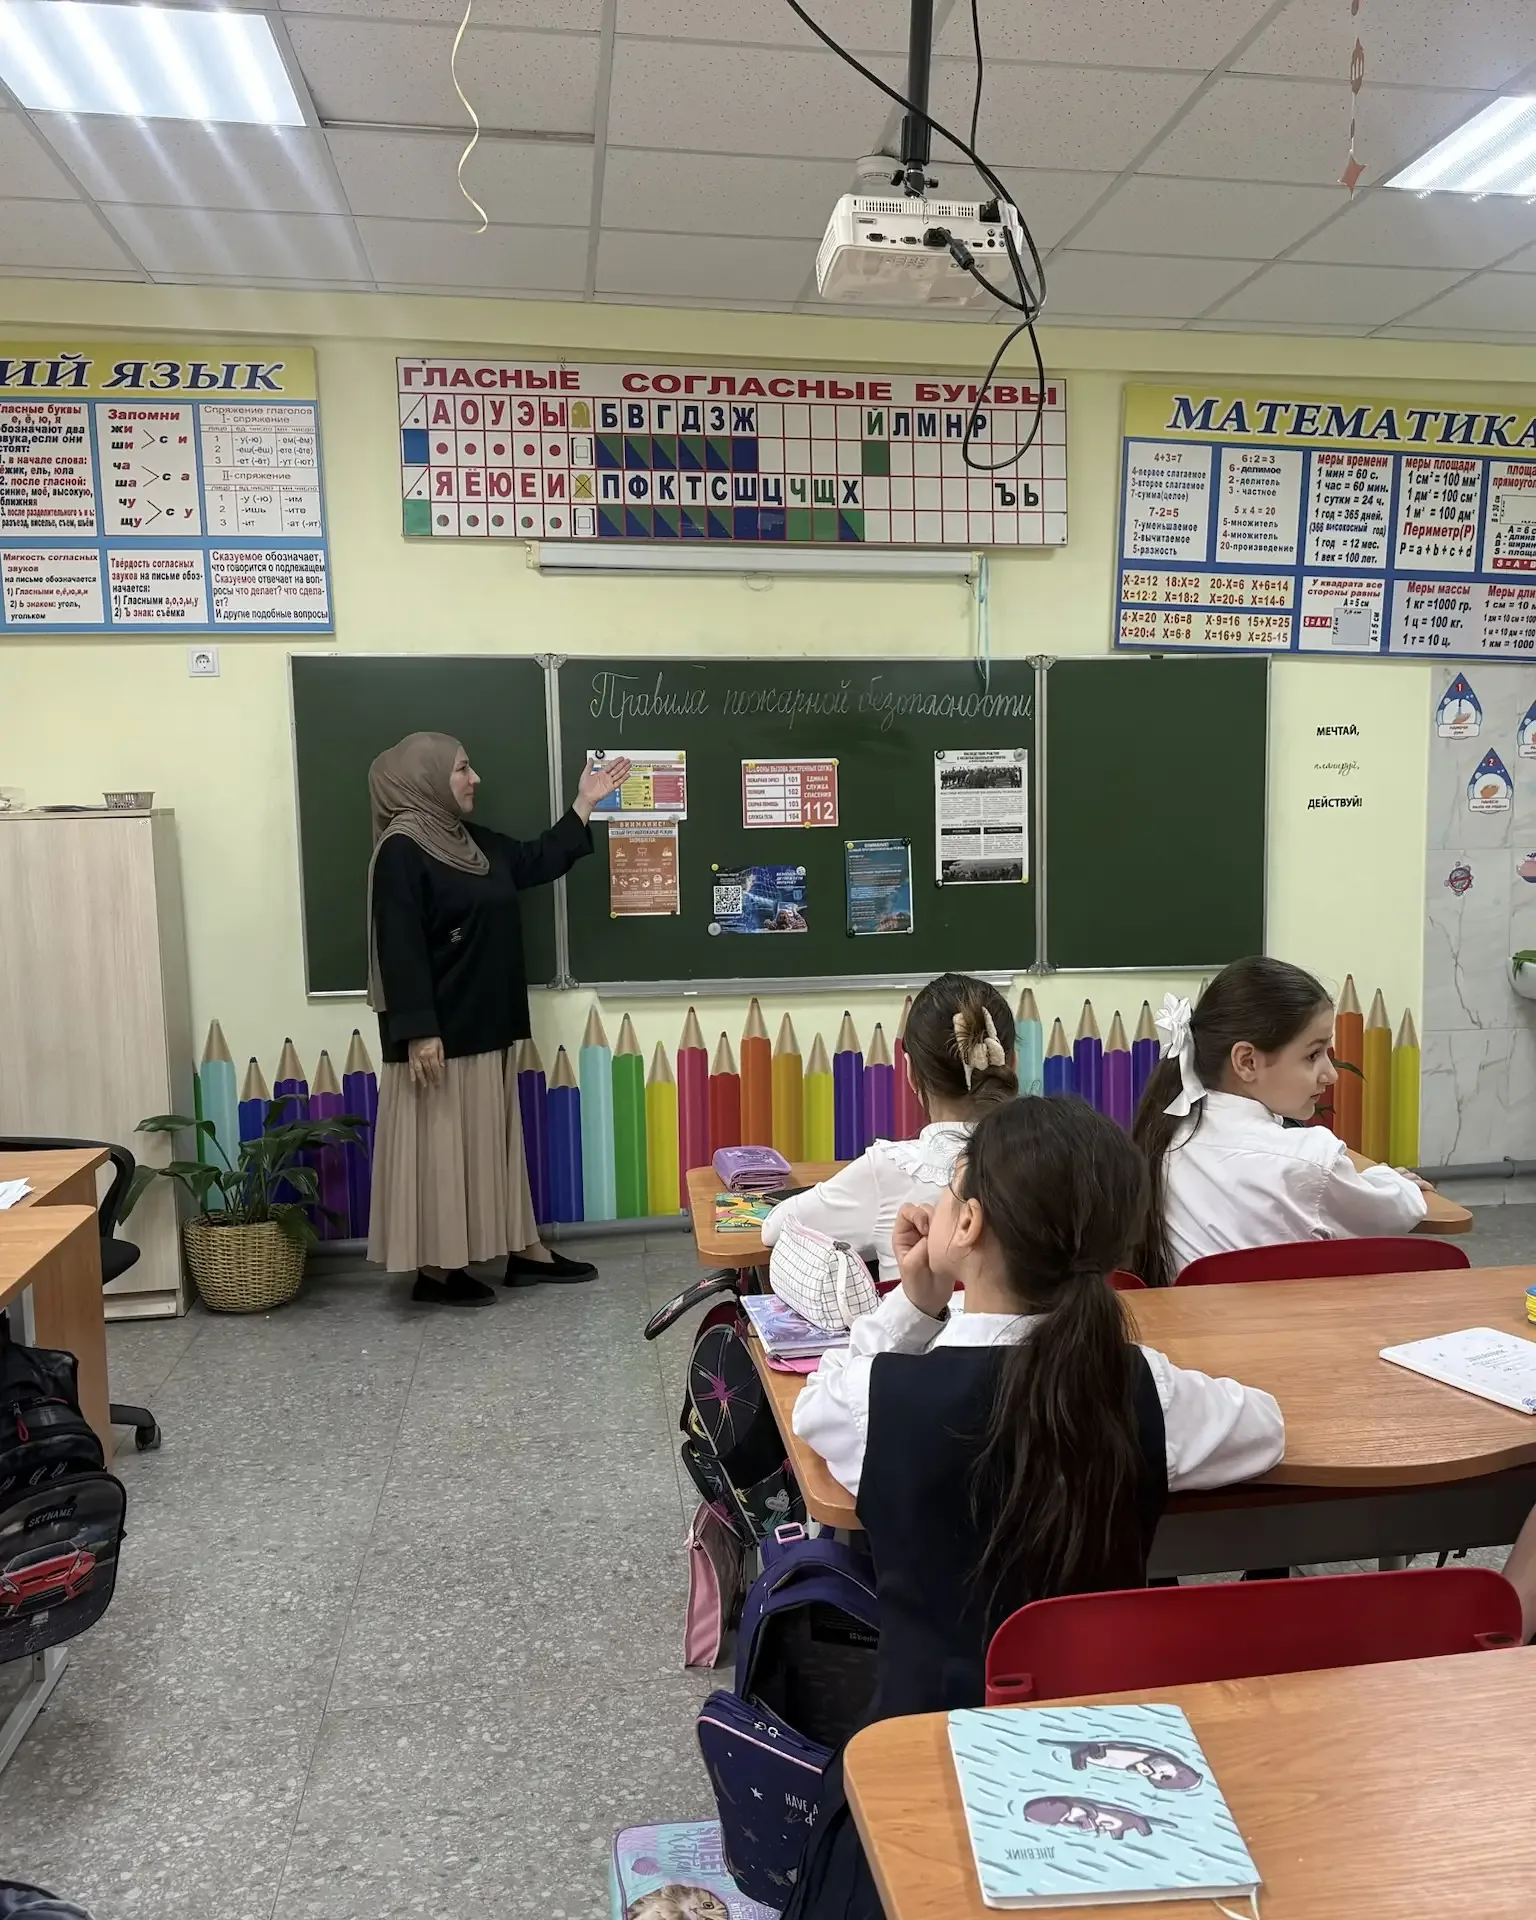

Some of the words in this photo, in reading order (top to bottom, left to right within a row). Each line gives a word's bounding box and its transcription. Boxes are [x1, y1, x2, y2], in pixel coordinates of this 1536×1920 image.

[102, 361, 284, 390] ЯЗЫК
[404, 367, 580, 390] ГЛАСНЫЕ
[622, 373, 892, 401] СОГЛАСНЫЕ
[916, 383, 1056, 405] БУКВЫ
[47, 404, 81, 415] буквы
[108, 409, 180, 420] Запомни
[432, 399, 451, 424] А
[461, 399, 479, 425] О
[490, 400, 505, 426] У
[517, 400, 535, 426] Э
[542, 401, 566, 427] Ы
[601, 403, 618, 428] Б
[627, 405, 645, 429] В
[657, 404, 672, 429] Г
[681, 405, 701, 432] Д
[710, 405, 725, 431] З
[732, 406, 756, 432] Ж
[866, 407, 884, 436] Й
[893, 412, 910, 437] Л
[917, 413, 937, 437] М
[946, 413, 962, 438] Н
[972, 413, 987, 438] Р
[65, 426, 85, 435] два
[111, 425, 133, 433] жи
[111, 441, 134, 449] ши
[178, 436, 188, 444] и
[113, 462, 130, 470] ча
[1317, 453, 1344, 467] меры
[1346, 455, 1389, 468] времени
[1405, 458, 1431, 471] меры
[1433, 459, 1476, 472] площади
[30, 468, 51, 476] ель,
[162, 473, 171, 481] с
[181, 473, 190, 481] а
[1166, 470, 1206, 479] слагаемое
[43, 476, 86, 485] гласной:
[115, 479, 137, 487] ша
[1165, 481, 1205, 490] слагаемое
[435, 471, 453, 497] Я
[465, 468, 482, 497] Ё
[488, 472, 512, 497] Ю
[520, 473, 537, 498] Е
[547, 473, 565, 498] И
[602, 474, 620, 500] П
[627, 474, 648, 500] Ф
[659, 475, 676, 500] К
[685, 475, 702, 500] Т
[711, 475, 728, 501] С
[734, 477, 757, 501] Ш
[762, 478, 782, 506] Ц
[790, 478, 806, 502] Ч
[814, 479, 835, 506] Щ
[842, 480, 859, 504] Х
[994, 483, 1016, 507] Ъ
[1023, 483, 1039, 507] Ь
[118, 498, 136, 508] чу
[165, 508, 175, 516] с
[184, 508, 193, 518] у
[120, 517, 142, 527] щу
[1325, 523, 1368, 532] високосный
[212, 551, 262, 563] Сказуемое
[265, 551, 322, 562] обозначает,
[211, 564, 224, 572] что
[226, 564, 267, 574] говорится
[275, 564, 326, 573] подлежащем
[214, 573, 256, 585] Сказуемое
[294, 576, 304, 584] на
[213, 587, 234, 597] росы
[250, 585, 282, 596] делает?
[1308, 589, 1348, 597] стороны
[1407, 581, 1435, 596] Меры
[1438, 585, 1471, 595] массы
[215, 609, 221, 618] И
[223, 610, 250, 620] другие
[252, 609, 291, 620] подобные
[293, 610, 328, 620] вопросы
[590, 671, 709, 735] Правила
[723, 679, 851, 730] пожарной
[1316, 724, 1360, 736] МЕЧТАЙ,
[1307, 795, 1363, 810] ДЕЙСТВУЙ!
[803, 801, 834, 820] 112
[28, 1507, 73, 1528] SKYNAME
[785, 1792, 808, 1813] HAVE
[1004, 1846, 1055, 1861] ДНЕВНИК
